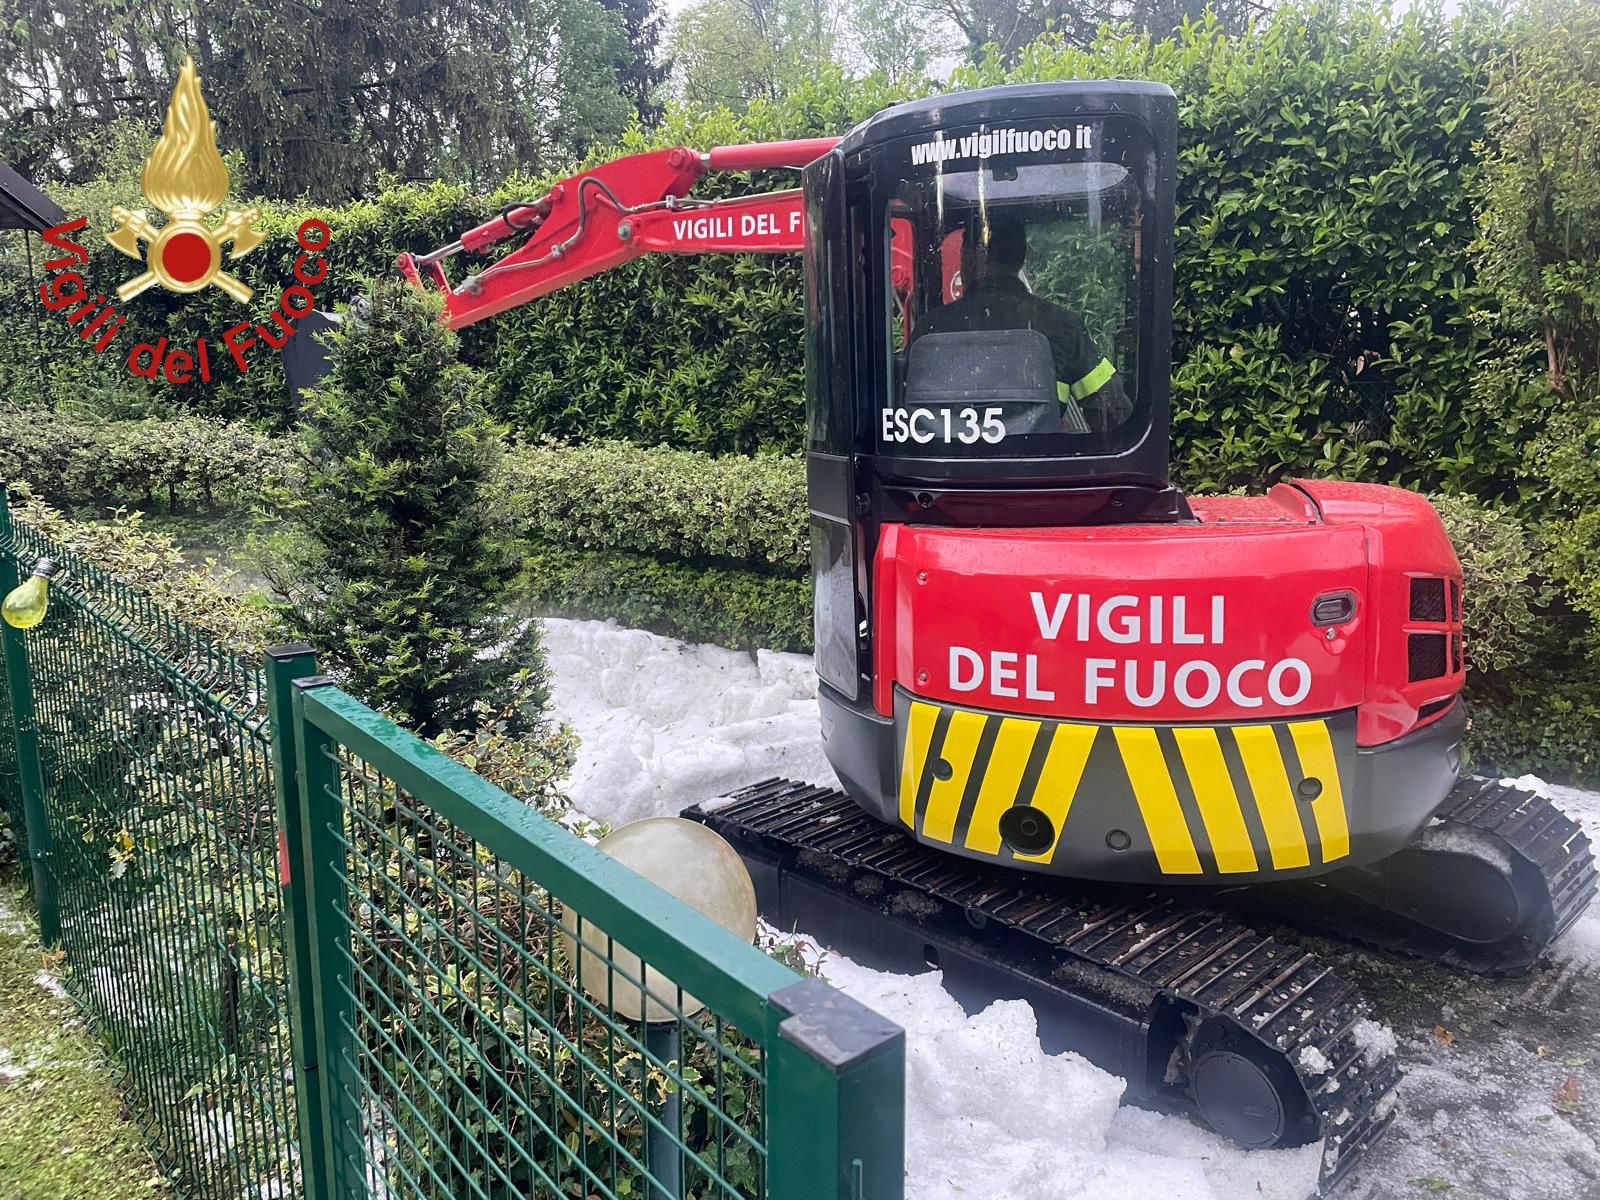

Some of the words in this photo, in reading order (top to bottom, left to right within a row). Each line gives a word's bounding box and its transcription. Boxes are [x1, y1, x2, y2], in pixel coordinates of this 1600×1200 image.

[911, 128, 1071, 166] www.vigilfuoco
[672, 216, 733, 241] VIGILI
[740, 213, 781, 237] DEL
[881, 407, 1006, 444] ESC135
[1029, 591, 1225, 645] VIGILI
[948, 646, 1055, 702] DEL
[1084, 657, 1312, 708] FUOCO
